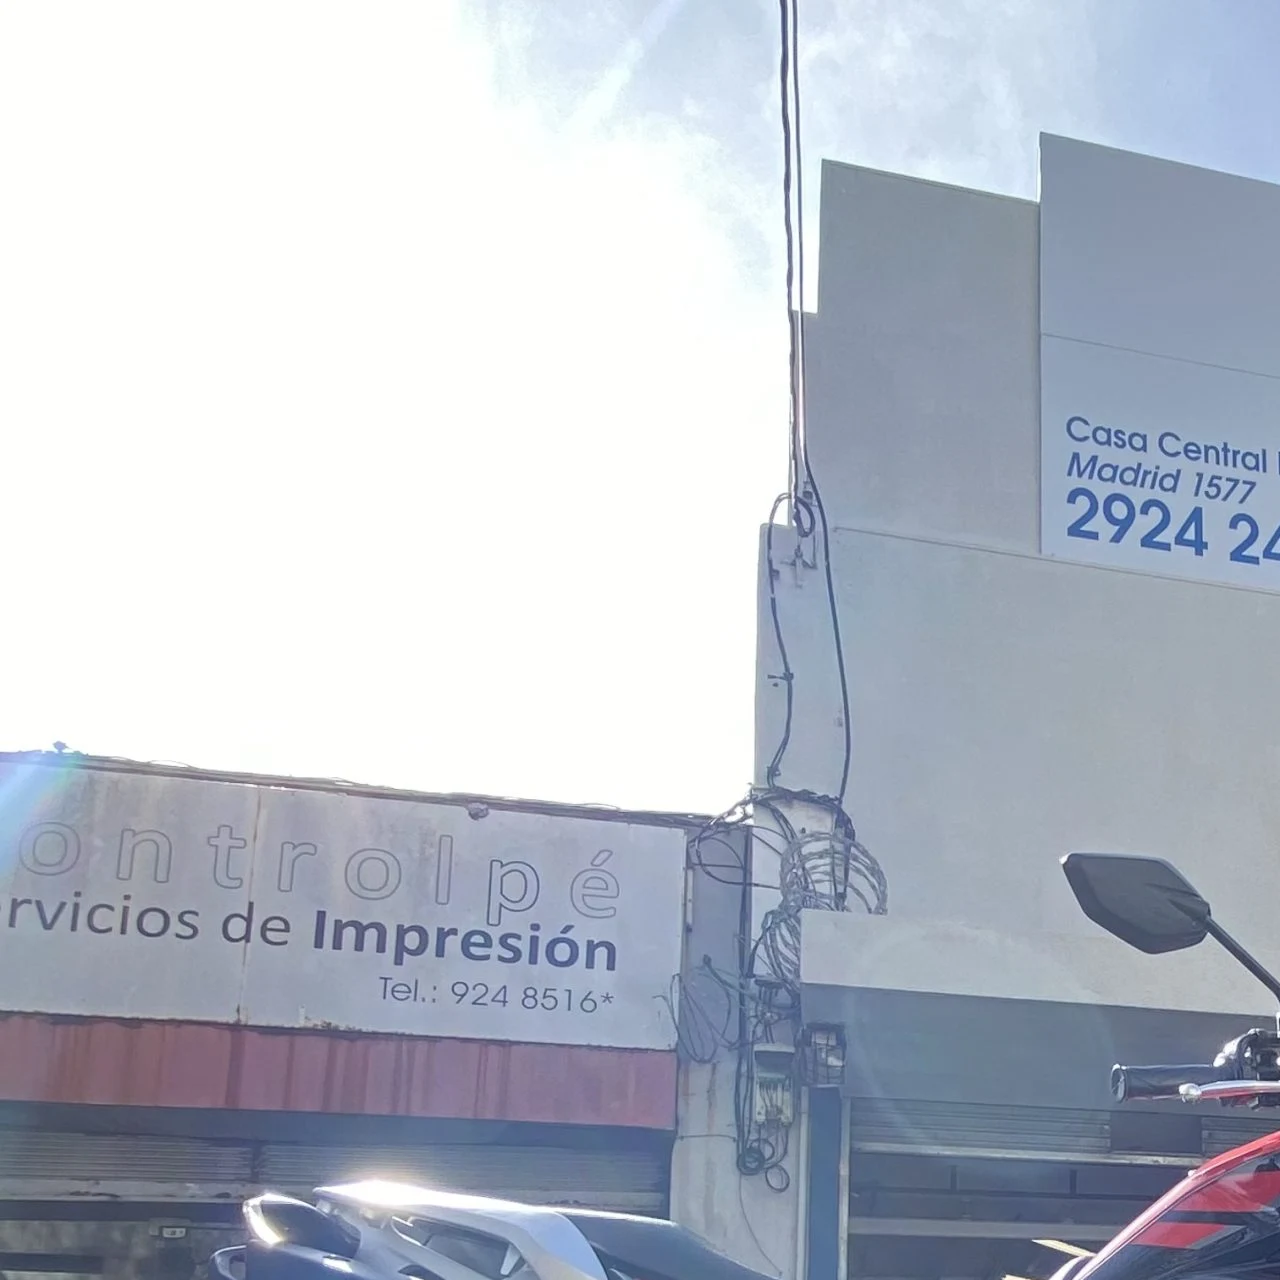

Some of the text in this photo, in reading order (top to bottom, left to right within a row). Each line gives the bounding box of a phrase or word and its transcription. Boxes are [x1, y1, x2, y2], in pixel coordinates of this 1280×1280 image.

[1065, 416, 1148, 453] Casa
[1158, 431, 1267, 473] Central
[1066, 452, 1256, 504] Madrid 1577
[1066, 487, 1208, 556] 2924
[0, 891, 617, 971] rvicios de Impresión
[379, 976, 437, 1004] Tel.:
[451, 981, 509, 1007] 924
